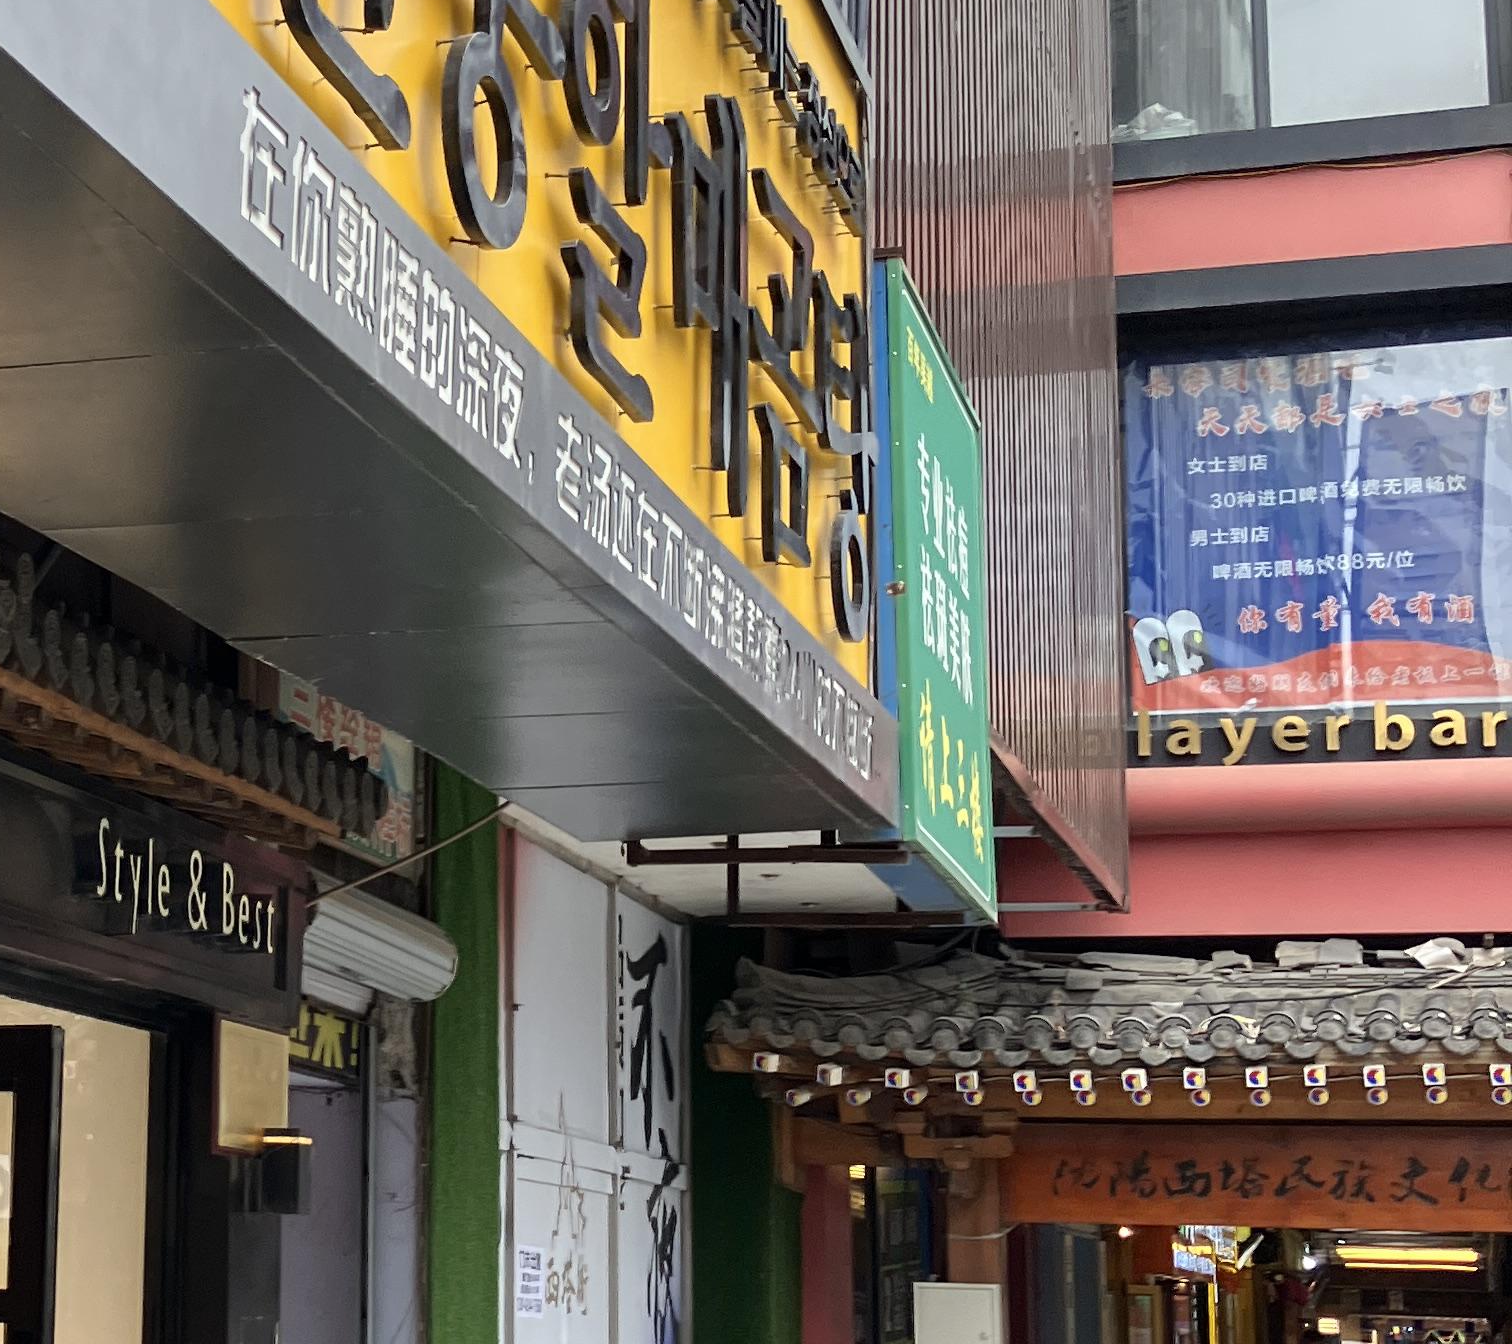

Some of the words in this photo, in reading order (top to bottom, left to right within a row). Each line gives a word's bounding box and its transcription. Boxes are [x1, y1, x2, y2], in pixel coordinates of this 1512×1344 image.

[1186, 453, 1269, 477] 女士到店
[1209, 473, 1469, 510] 30种进口啤酒免费无限畅饮
[916, 432, 972, 602] 专业祛痘
[1188, 525, 1271, 548] 男士到店
[1211, 549, 1417, 582] 啤酒无限畅饮88元/位
[918, 542, 975, 707] 祛斑美肤
[1371, 699, 1509, 752] bar
[95, 814, 173, 936] Style
[186, 847, 209, 932] &
[221, 860, 276, 956] Best
